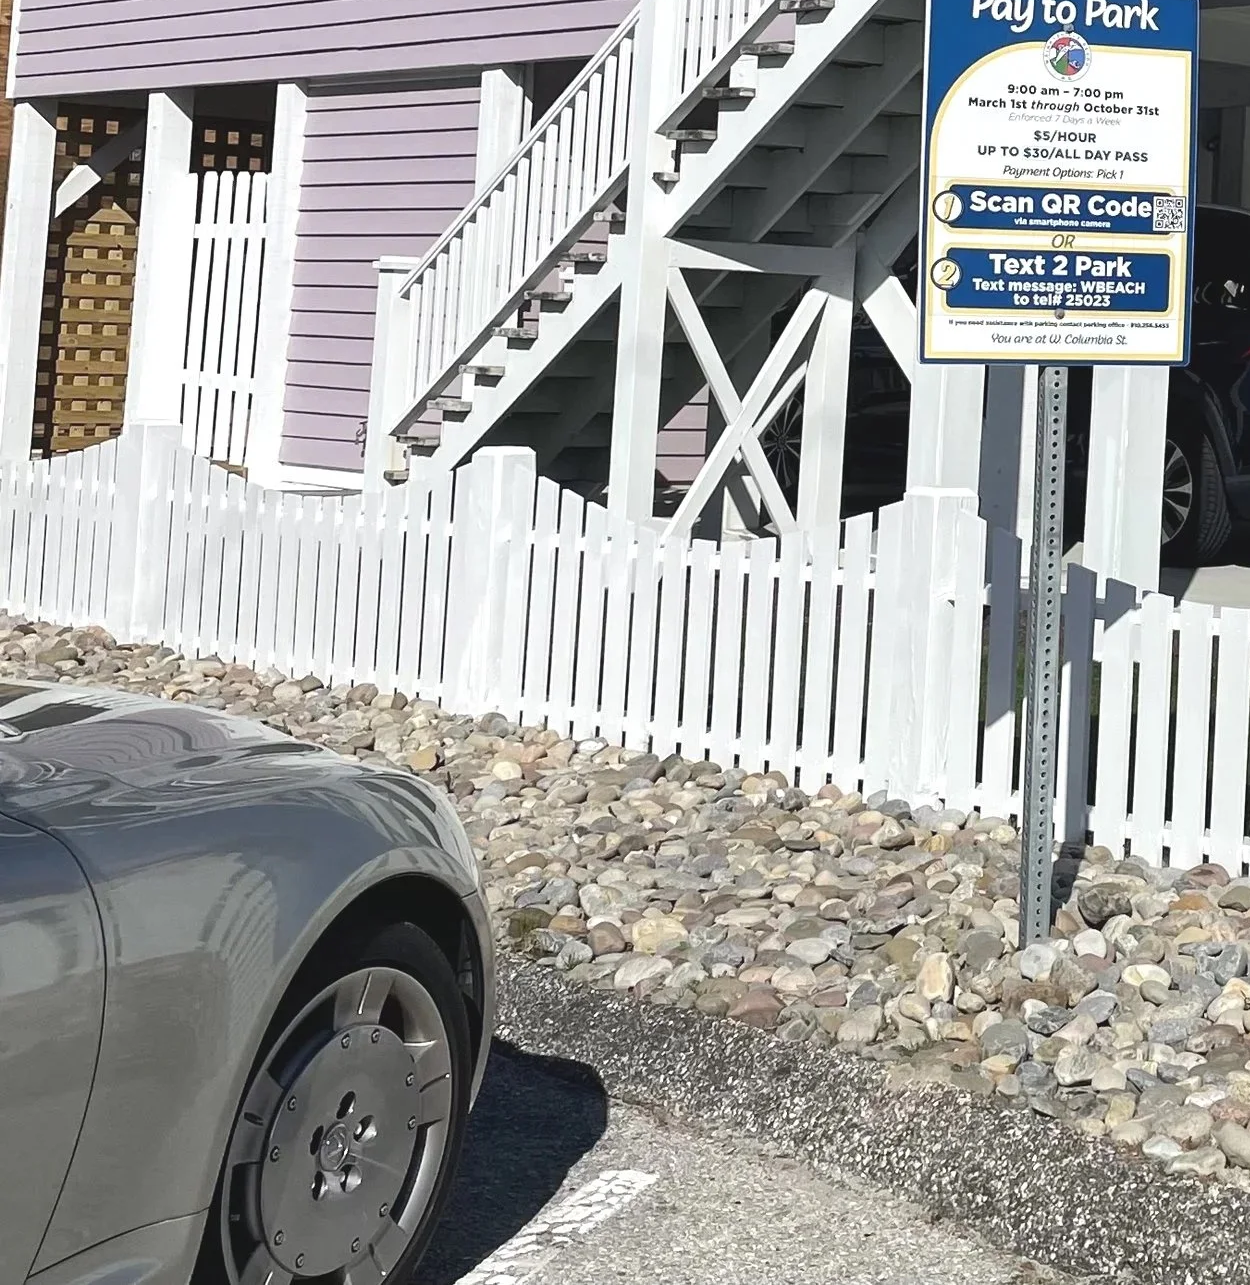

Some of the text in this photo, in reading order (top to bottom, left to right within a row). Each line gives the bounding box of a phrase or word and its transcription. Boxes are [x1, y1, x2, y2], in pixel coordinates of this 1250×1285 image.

[1007, 84, 1037, 94] 9:00
[1041, 87, 1060, 96] am
[1073, 88, 1101, 98] 7:00
[1105, 90, 1123, 100] pm
[968, 97, 1159, 116] March 1st through October 31st
[1008, 112, 1051, 122] Enforced
[1055, 114, 1060, 122] 7
[1062, 115, 1085, 125] Days
[1096, 116, 1122, 126] Week
[1034, 130, 1096, 143] $5/HOUR
[977, 146, 1149, 162] UP TO $30/ALL DAY PASS
[1003, 165, 1123, 180] Payment Options: Pick 1
[970, 190, 1152, 218] Scan QR Code
[1029, 219, 1079, 228] smartphone
[1081, 220, 1111, 228] camera
[1052, 235, 1075, 248] OR
[989, 254, 1132, 277] Text 2 Park
[972, 278, 1145, 296] Text message: WBEACH
[1014, 294, 1111, 307] to tel# 25023
[991, 332, 1012, 344] You
[1014, 335, 1032, 344] are
[1035, 334, 1047, 344] at
[1064, 334, 1114, 345] Columbia
[1116, 335, 1128, 345] St.
